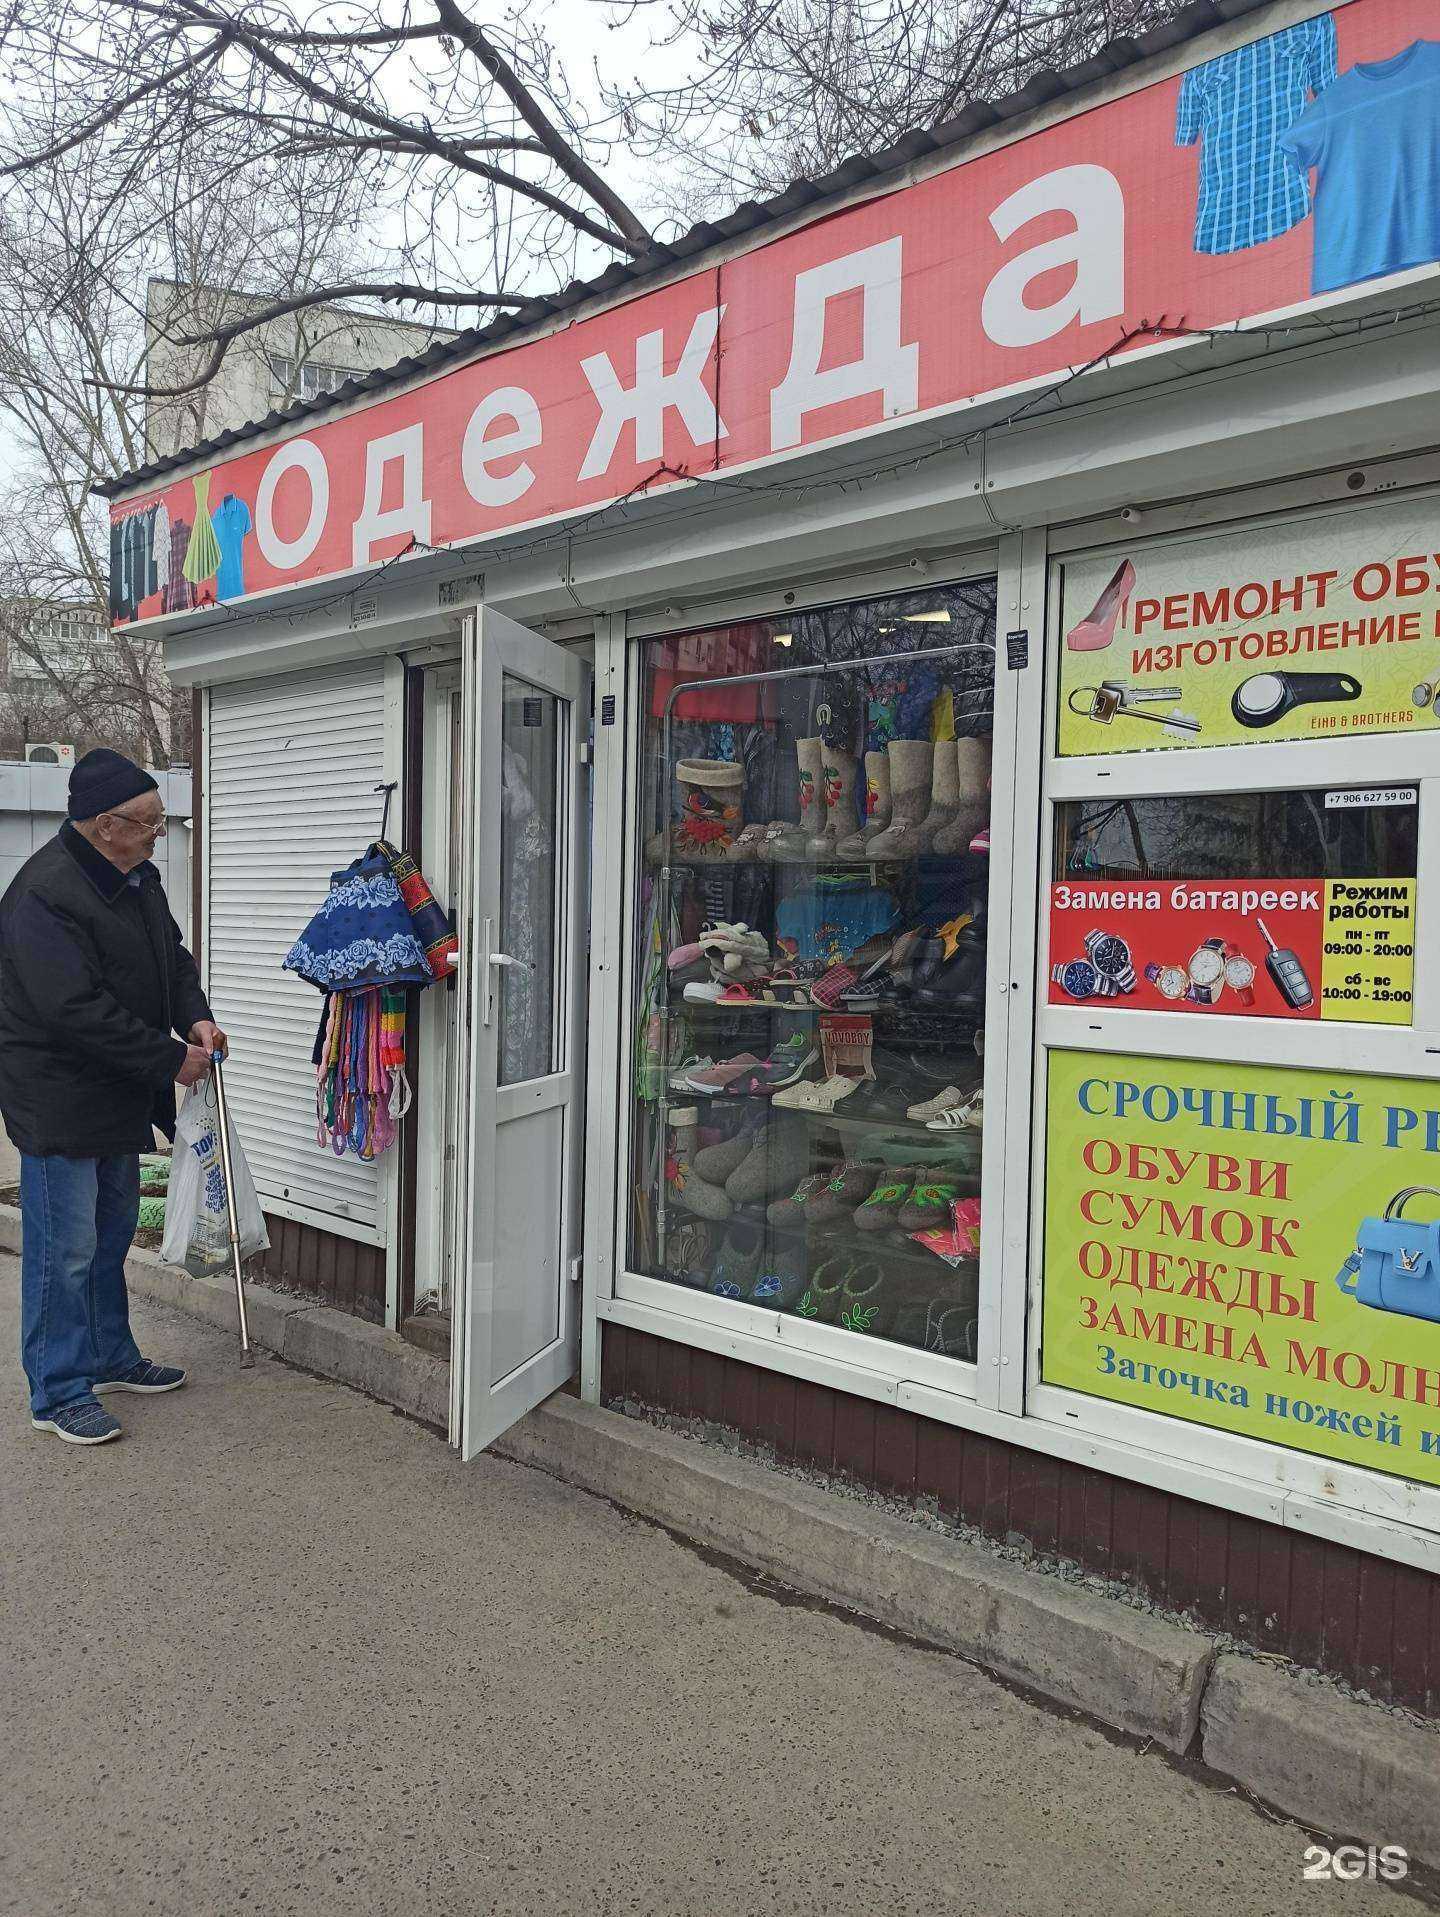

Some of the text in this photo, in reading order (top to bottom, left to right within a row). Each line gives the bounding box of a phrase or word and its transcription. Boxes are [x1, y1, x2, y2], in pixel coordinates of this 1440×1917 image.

[1134, 553, 1440, 634] РЕМОНТ ОБ
[1132, 612, 1421, 674] ИЗГОТОВЛЕНИЕ
[1352, 710, 1414, 726] BROTHERS
[1329, 791, 1412, 804] +7 906 627 59 00
[1054, 884, 1320, 916] Замена батареек
[1332, 883, 1408, 900] Режим
[1329, 900, 1409, 921] работы
[1324, 943, 1363, 955] 09:00
[1373, 944, 1413, 956] 20:00
[1345, 930, 1362, 940] пн
[1374, 930, 1390, 940] пт
[1322, 988, 1361, 1000] 10:00
[1372, 990, 1411, 1002] 19:00
[1344, 972, 1362, 985] сб
[1373, 976, 1391, 986] вс
[1078, 1079, 1365, 1145] СРОЧНЫЙ
[1083, 1139, 1294, 1201] ОБУВИ
[1080, 1189, 1300, 1258] СУМОК
[1078, 1240, 1319, 1323] ОДЕЖДЫ
[1078, 1296, 1270, 1369] ЗАМЕНА
[1096, 1344, 1250, 1408] Заточка
[1264, 1392, 1402, 1447] ножей
